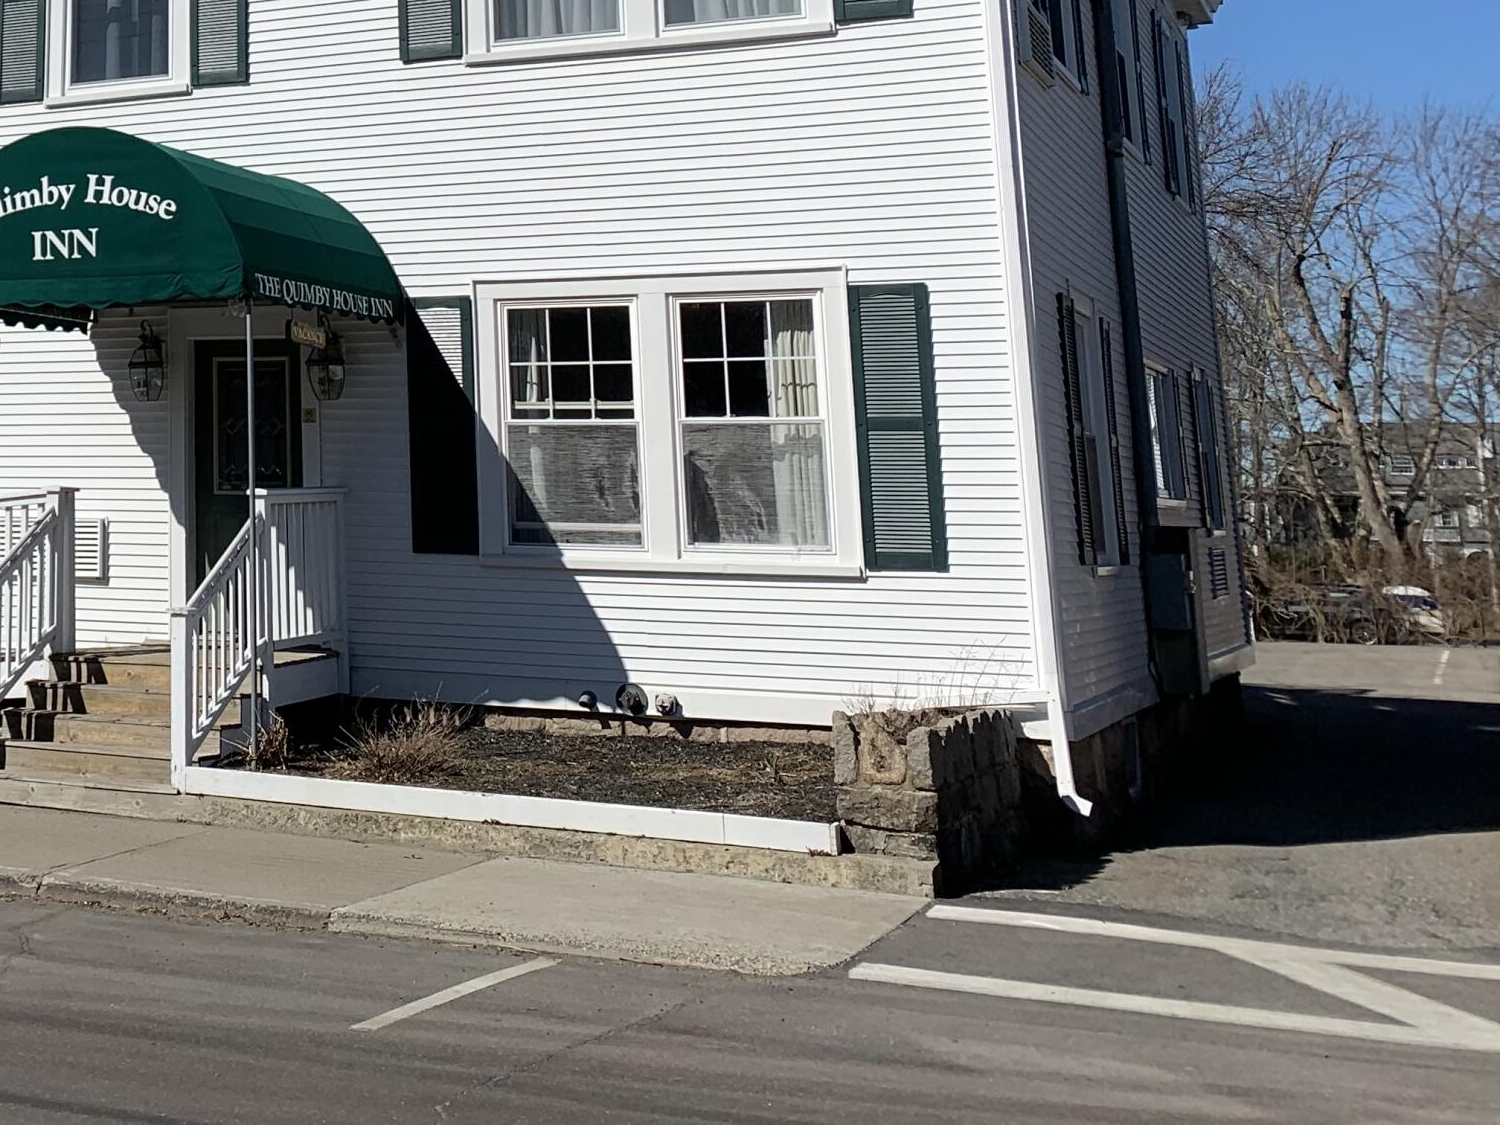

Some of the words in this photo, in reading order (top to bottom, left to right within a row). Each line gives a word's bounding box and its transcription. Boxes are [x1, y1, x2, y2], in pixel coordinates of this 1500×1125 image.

[84, 173, 178, 221] House
[31, 228, 99, 262] INN
[255, 273, 282, 298] THE
[283, 279, 331, 308] QUIMBY
[332, 289, 369, 316] HOUSE
[371, 297, 394, 318] INN
[293, 325, 325, 344] VACANCY
